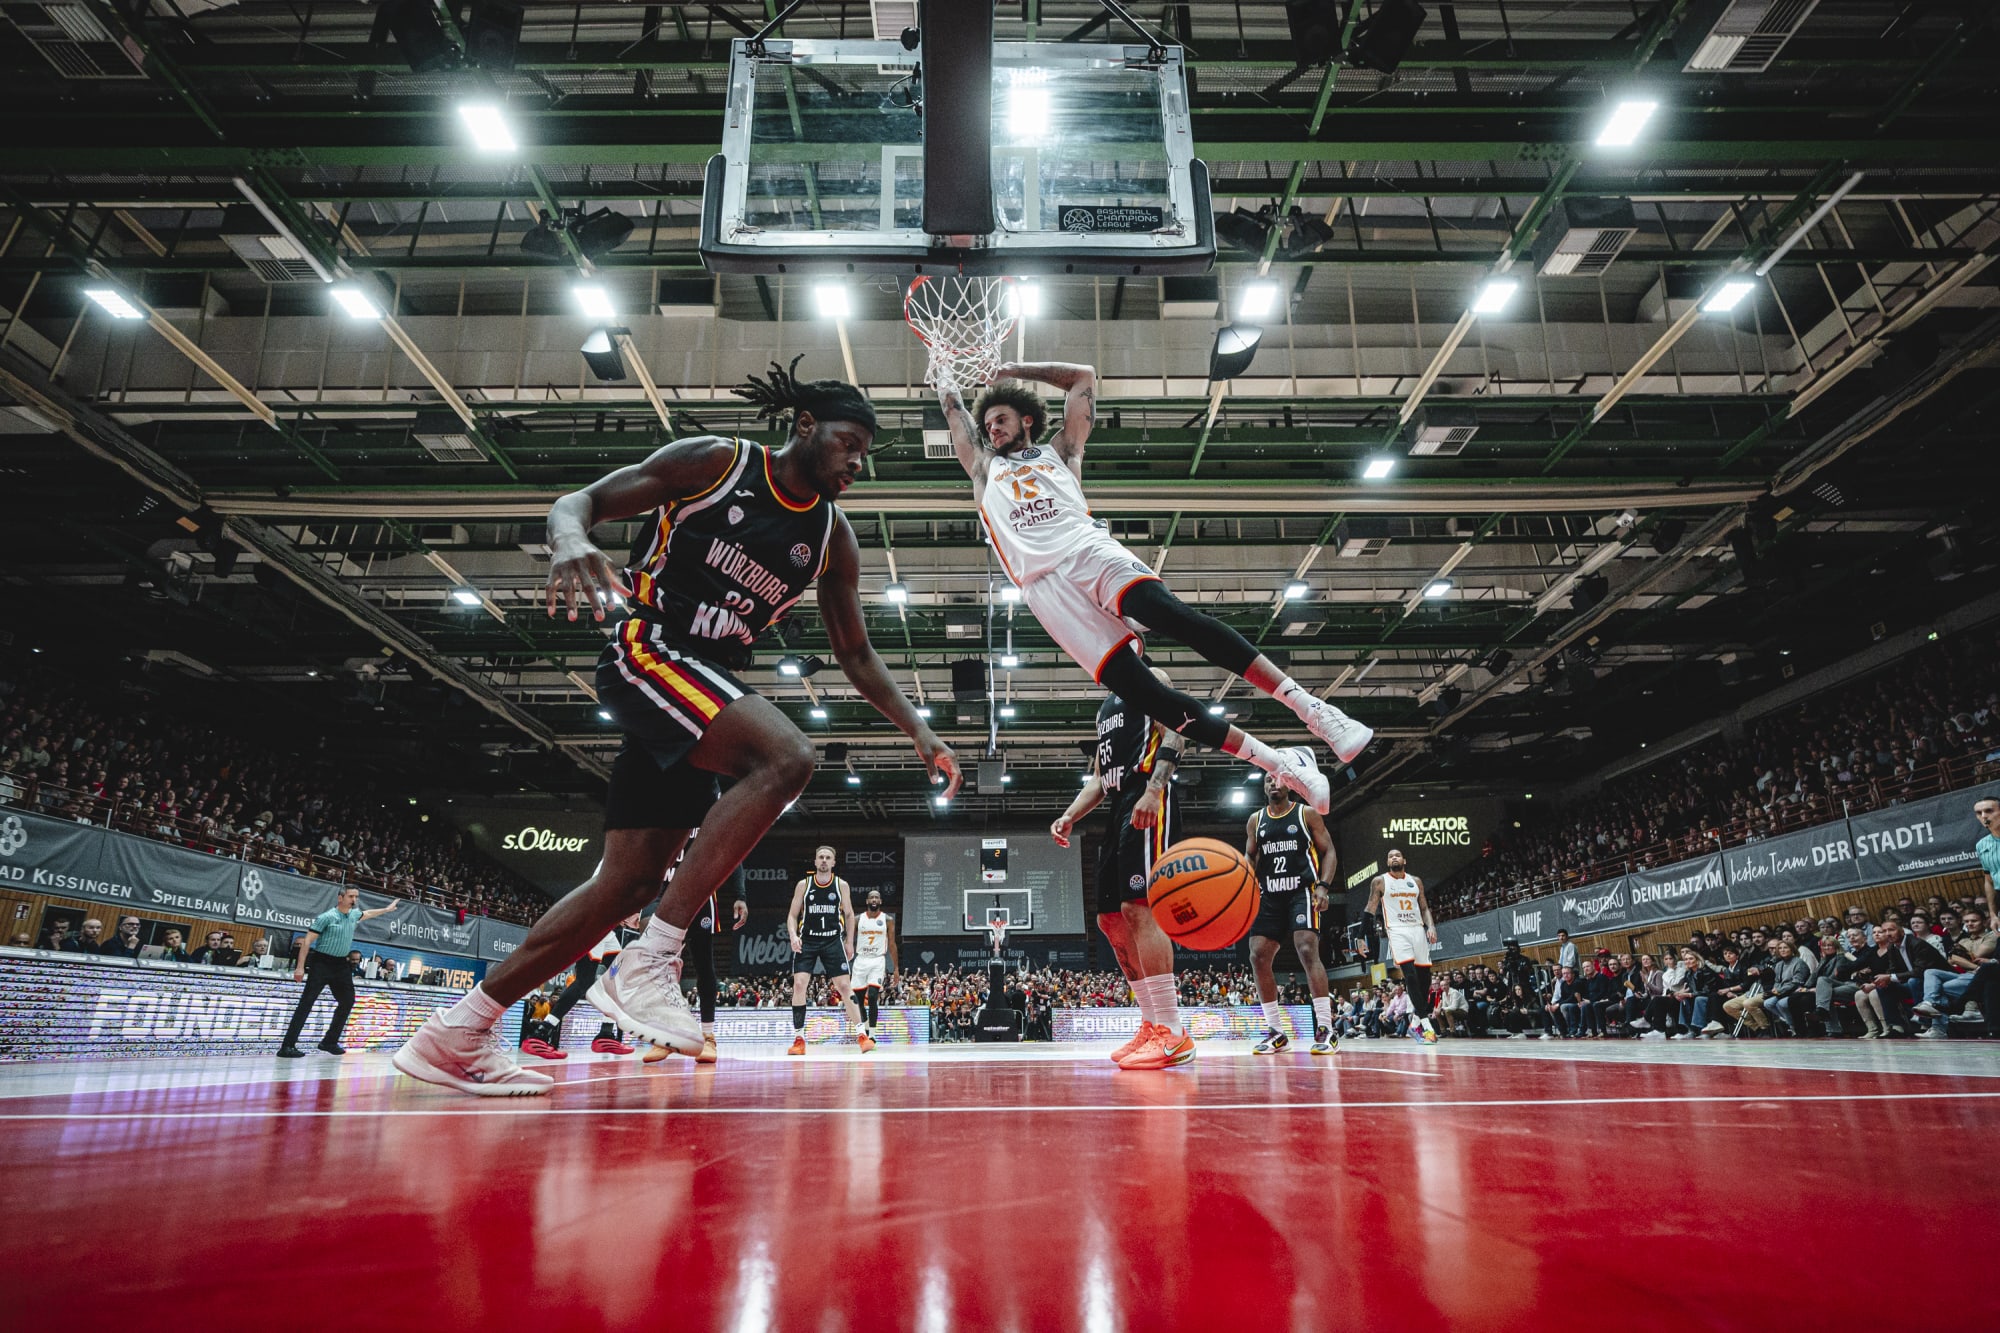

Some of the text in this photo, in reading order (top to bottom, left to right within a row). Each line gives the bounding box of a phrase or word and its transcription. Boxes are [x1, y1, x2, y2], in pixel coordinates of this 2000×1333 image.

[1096, 214, 1159, 222] CHAMPIONS
[1012, 478, 1040, 502] 13
[1009, 498, 1055, 521] @MCT
[704, 537, 789, 606] WÜRZBURG
[1099, 739, 1112, 766] 55
[1389, 816, 1468, 832] MERCATOR
[502, 827, 589, 852] s.Oliver
[1262, 840, 1298, 855] WÜRZBURG
[1408, 831, 1471, 846] LEASING
[1812, 821, 1934, 867] DER STADT!
[845, 851, 896, 864] BECK
[1273, 856, 1287, 874] 22
[1898, 850, 1979, 872] stadtbau-wuerzbur
[0, 865, 133, 898] AD KISSINGEN
[1266, 875, 1301, 893] KNAUF
[1632, 852, 1808, 905] DEIN PLATZ IM besten Team
[151, 889, 230, 914] SPIELBANK
[236, 903, 262, 919] BAD
[1398, 899, 1413, 910] 12
[1577, 893, 1624, 917] STADTBAU
[820, 916, 826, 929] 1
[1512, 910, 1542, 937] KNAUF
[1600, 911, 1626, 922] Würzburg
[390, 920, 439, 942] elements
[868, 936, 875, 945] 7
[958, 949, 979, 958] Komm
[1007, 949, 1025, 958] Team
[89, 990, 288, 1041] FOUNDED
[1073, 1016, 1142, 1033] FOUNDE
